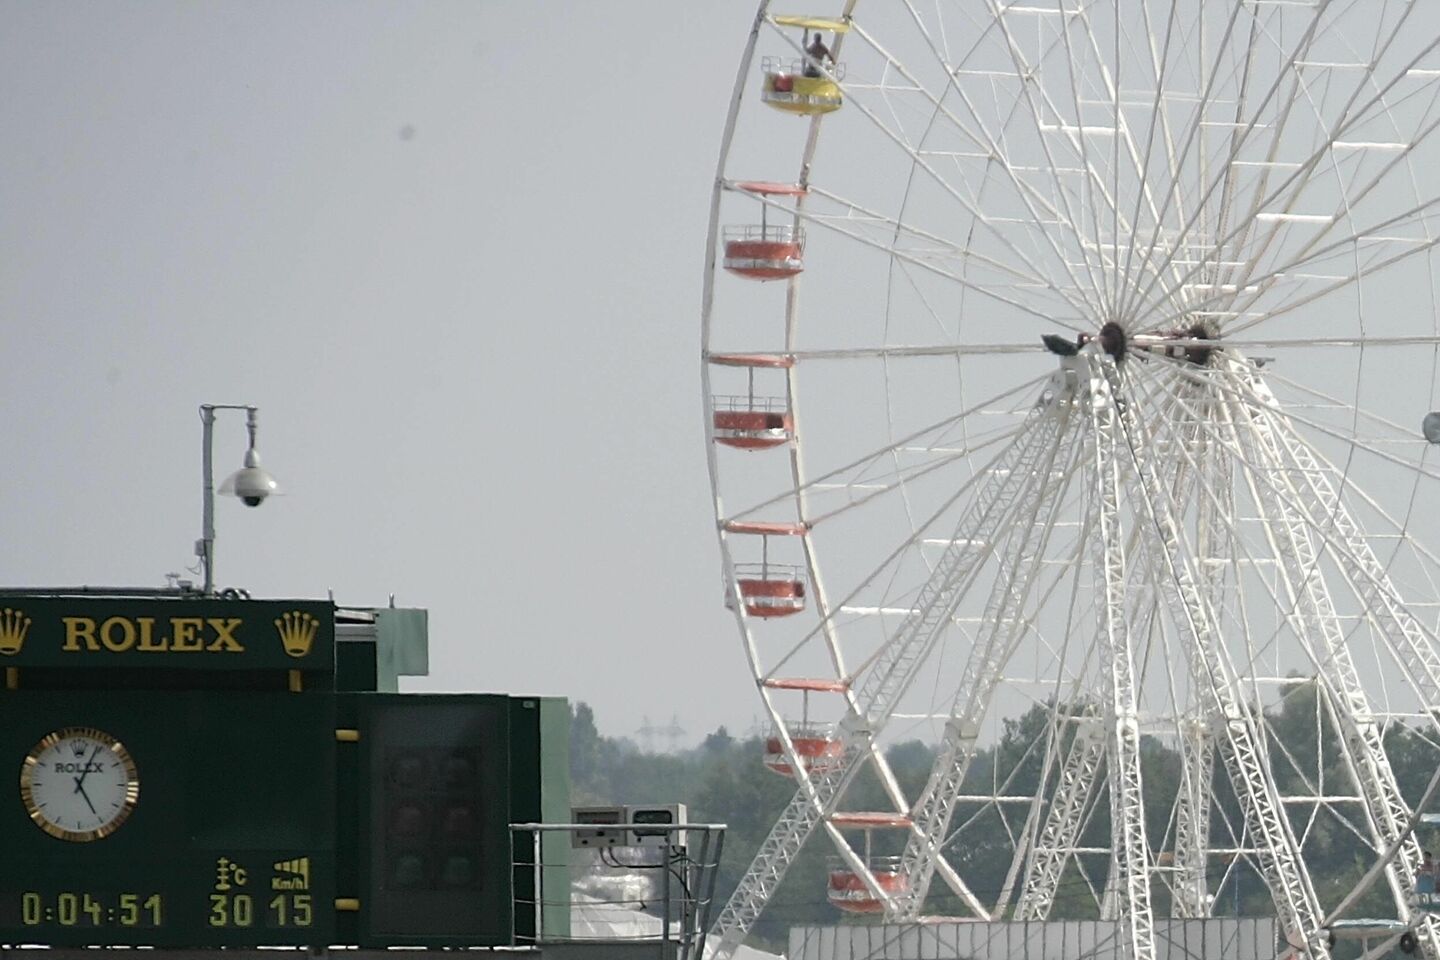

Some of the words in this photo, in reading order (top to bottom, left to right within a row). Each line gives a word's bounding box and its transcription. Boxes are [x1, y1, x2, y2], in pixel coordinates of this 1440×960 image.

[62, 616, 244, 652] ROLEX
[54, 762, 104, 773] ROLEX
[272, 877, 304, 890] Km/h
[22, 892, 162, 926] 0:04:51
[210, 894, 252, 926] 30
[270, 894, 312, 926] 15
